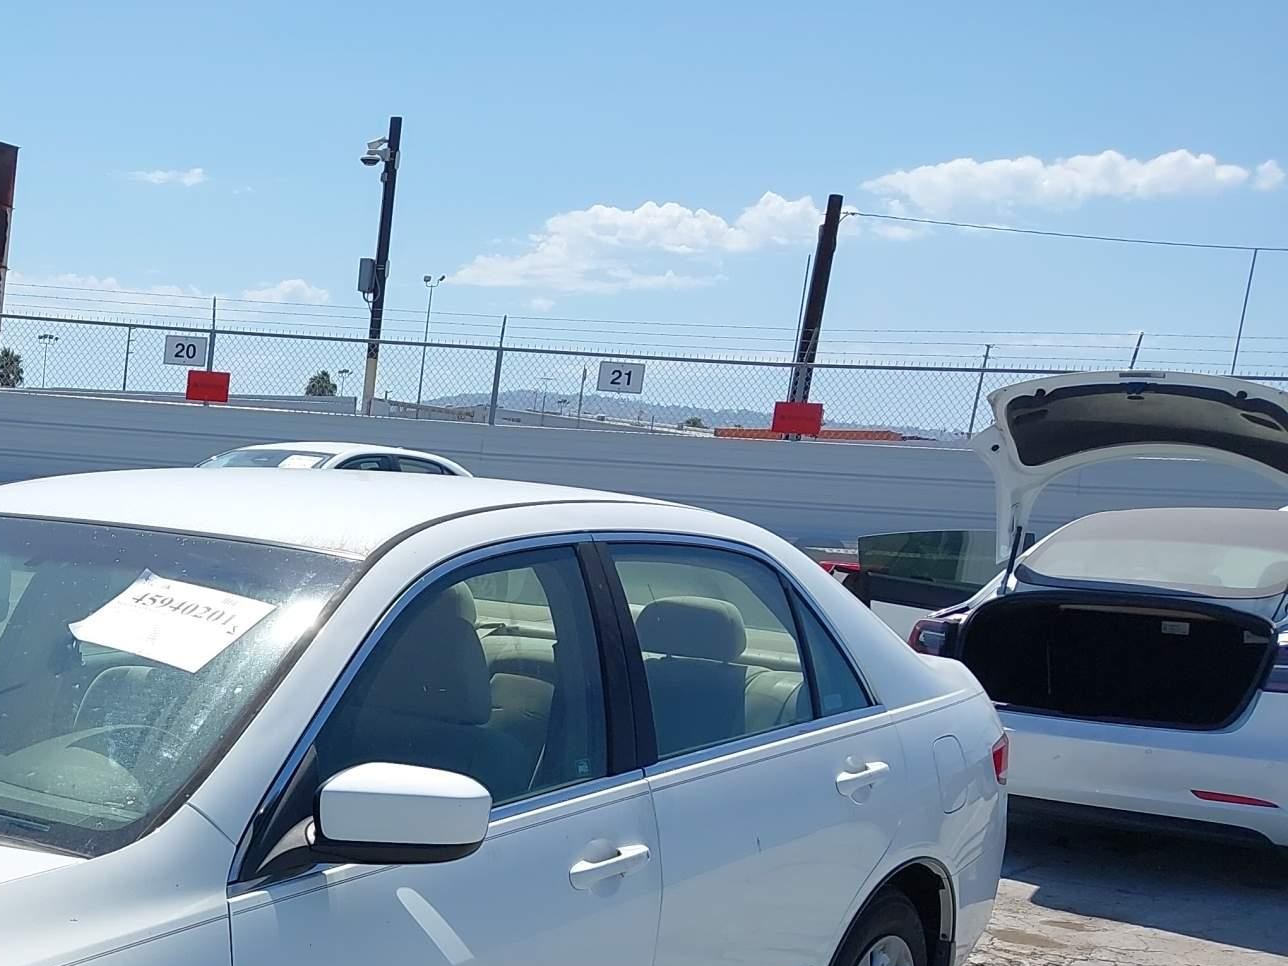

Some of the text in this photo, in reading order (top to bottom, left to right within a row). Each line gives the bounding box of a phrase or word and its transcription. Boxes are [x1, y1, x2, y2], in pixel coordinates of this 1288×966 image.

[174, 343, 196, 359] 20
[610, 369, 632, 386] 21
[132, 593, 237, 625] 45940201
